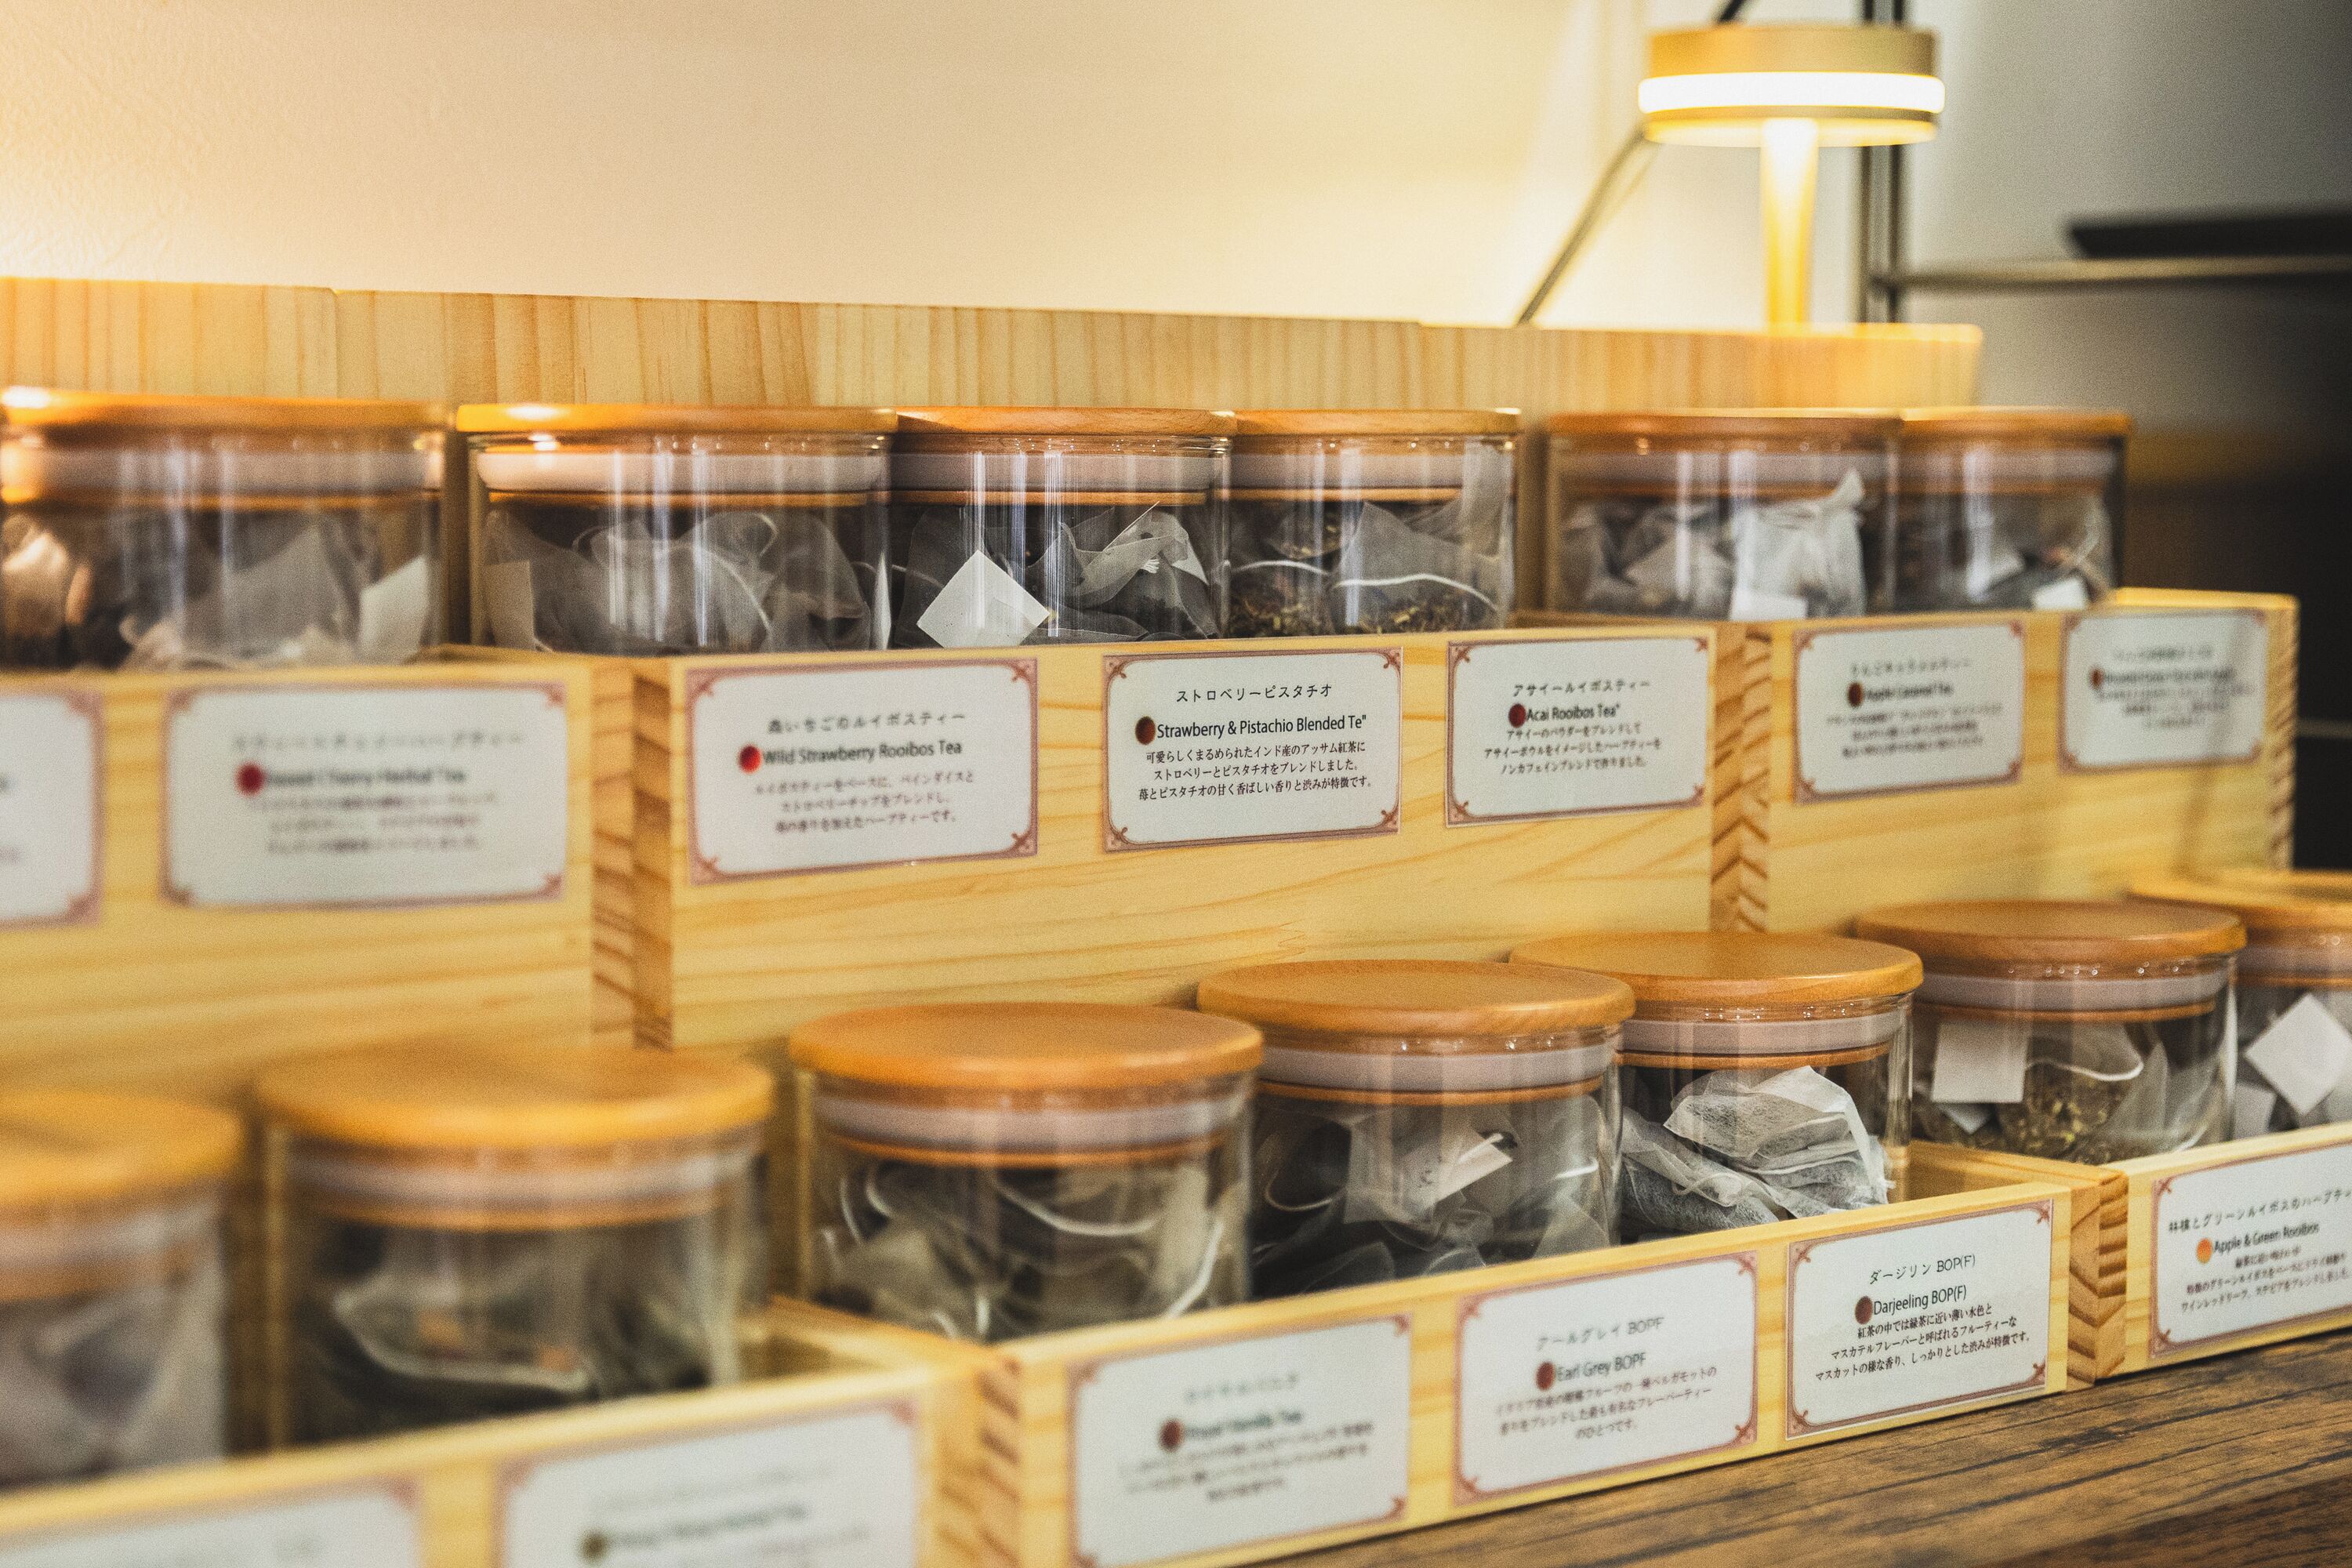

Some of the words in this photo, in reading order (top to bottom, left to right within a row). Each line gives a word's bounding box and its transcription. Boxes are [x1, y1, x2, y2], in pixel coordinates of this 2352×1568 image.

[1176, 683, 1332, 703] ストロベリーピスタチオ
[1526, 706, 1549, 721] Acai
[1552, 704, 1594, 720] Rooibos
[1157, 721, 1225, 739] Strawberry
[1228, 720, 1236, 735] &
[1240, 718, 1294, 735] Pistachio
[1297, 715, 1345, 732] Blended
[763, 748, 795, 765] Wild
[798, 745, 876, 765] Strawberry
[879, 741, 935, 759] Rooibos
[938, 739, 963, 756] Tea
[1146, 741, 1366, 764] 可愛らしくまるめられたインド産のアッサム紅茶に
[1154, 758, 1358, 781] ストロベリーとピスタチオをブレンドしました。
[1138, 775, 1371, 800] 苺とピスタチオの甘く香ばしい香りと渋みが特徴です。
[2214, 1235, 2241, 1254] Apple
[2244, 1234, 2251, 1247] &
[2253, 1230, 2281, 1246] Green
[1870, 1263, 1932, 1285] ダージリン
[1936, 1254, 1976, 1273] BOP(F)
[1874, 1292, 1929, 1316] Darjeeling
[1932, 1283, 1967, 1305] BOP(F)
[1857, 1302, 1993, 1339] 紅茶の中では緑茶に近い薄い水色と
[1537, 1325, 1623, 1352] アールグレイ
[1628, 1316, 1665, 1336] BOPF
[1831, 1316, 2018, 1361] マスカテルフレーバーと呼ばれるフルーティーな
[1557, 1365, 1581, 1382] Earl
[1583, 1360, 1611, 1379] Grey
[1615, 1352, 1647, 1371] BOPF
[1815, 1331, 2030, 1381] マスカットの様な香り、しっかりとした渋みが特徴です。
